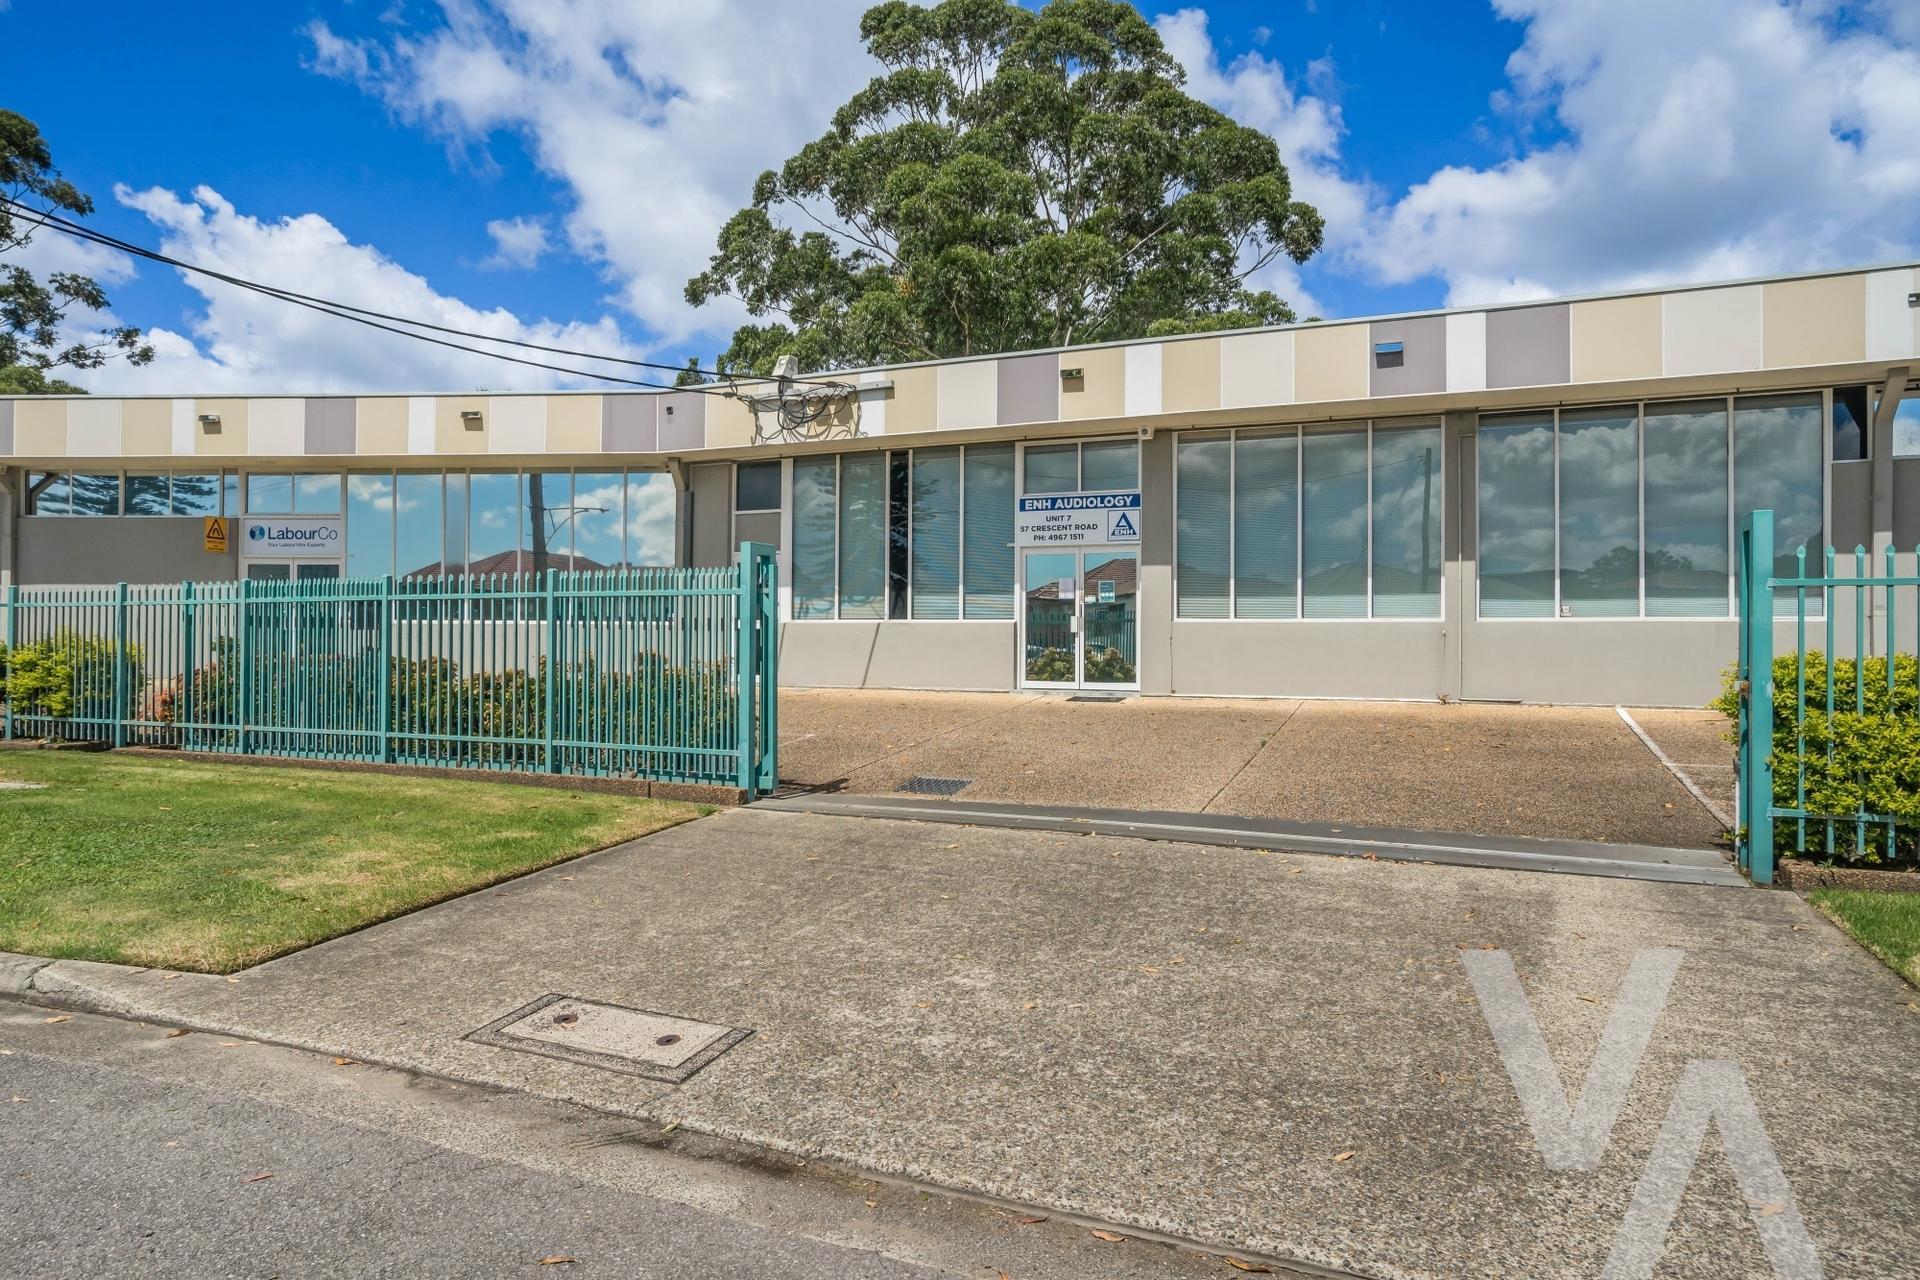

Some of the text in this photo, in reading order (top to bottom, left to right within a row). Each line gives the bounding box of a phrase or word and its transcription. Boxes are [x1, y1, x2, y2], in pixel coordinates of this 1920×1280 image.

[1025, 496, 1133, 510] ENH AUDIOLOGY
[268, 527, 338, 540] LabourCo
